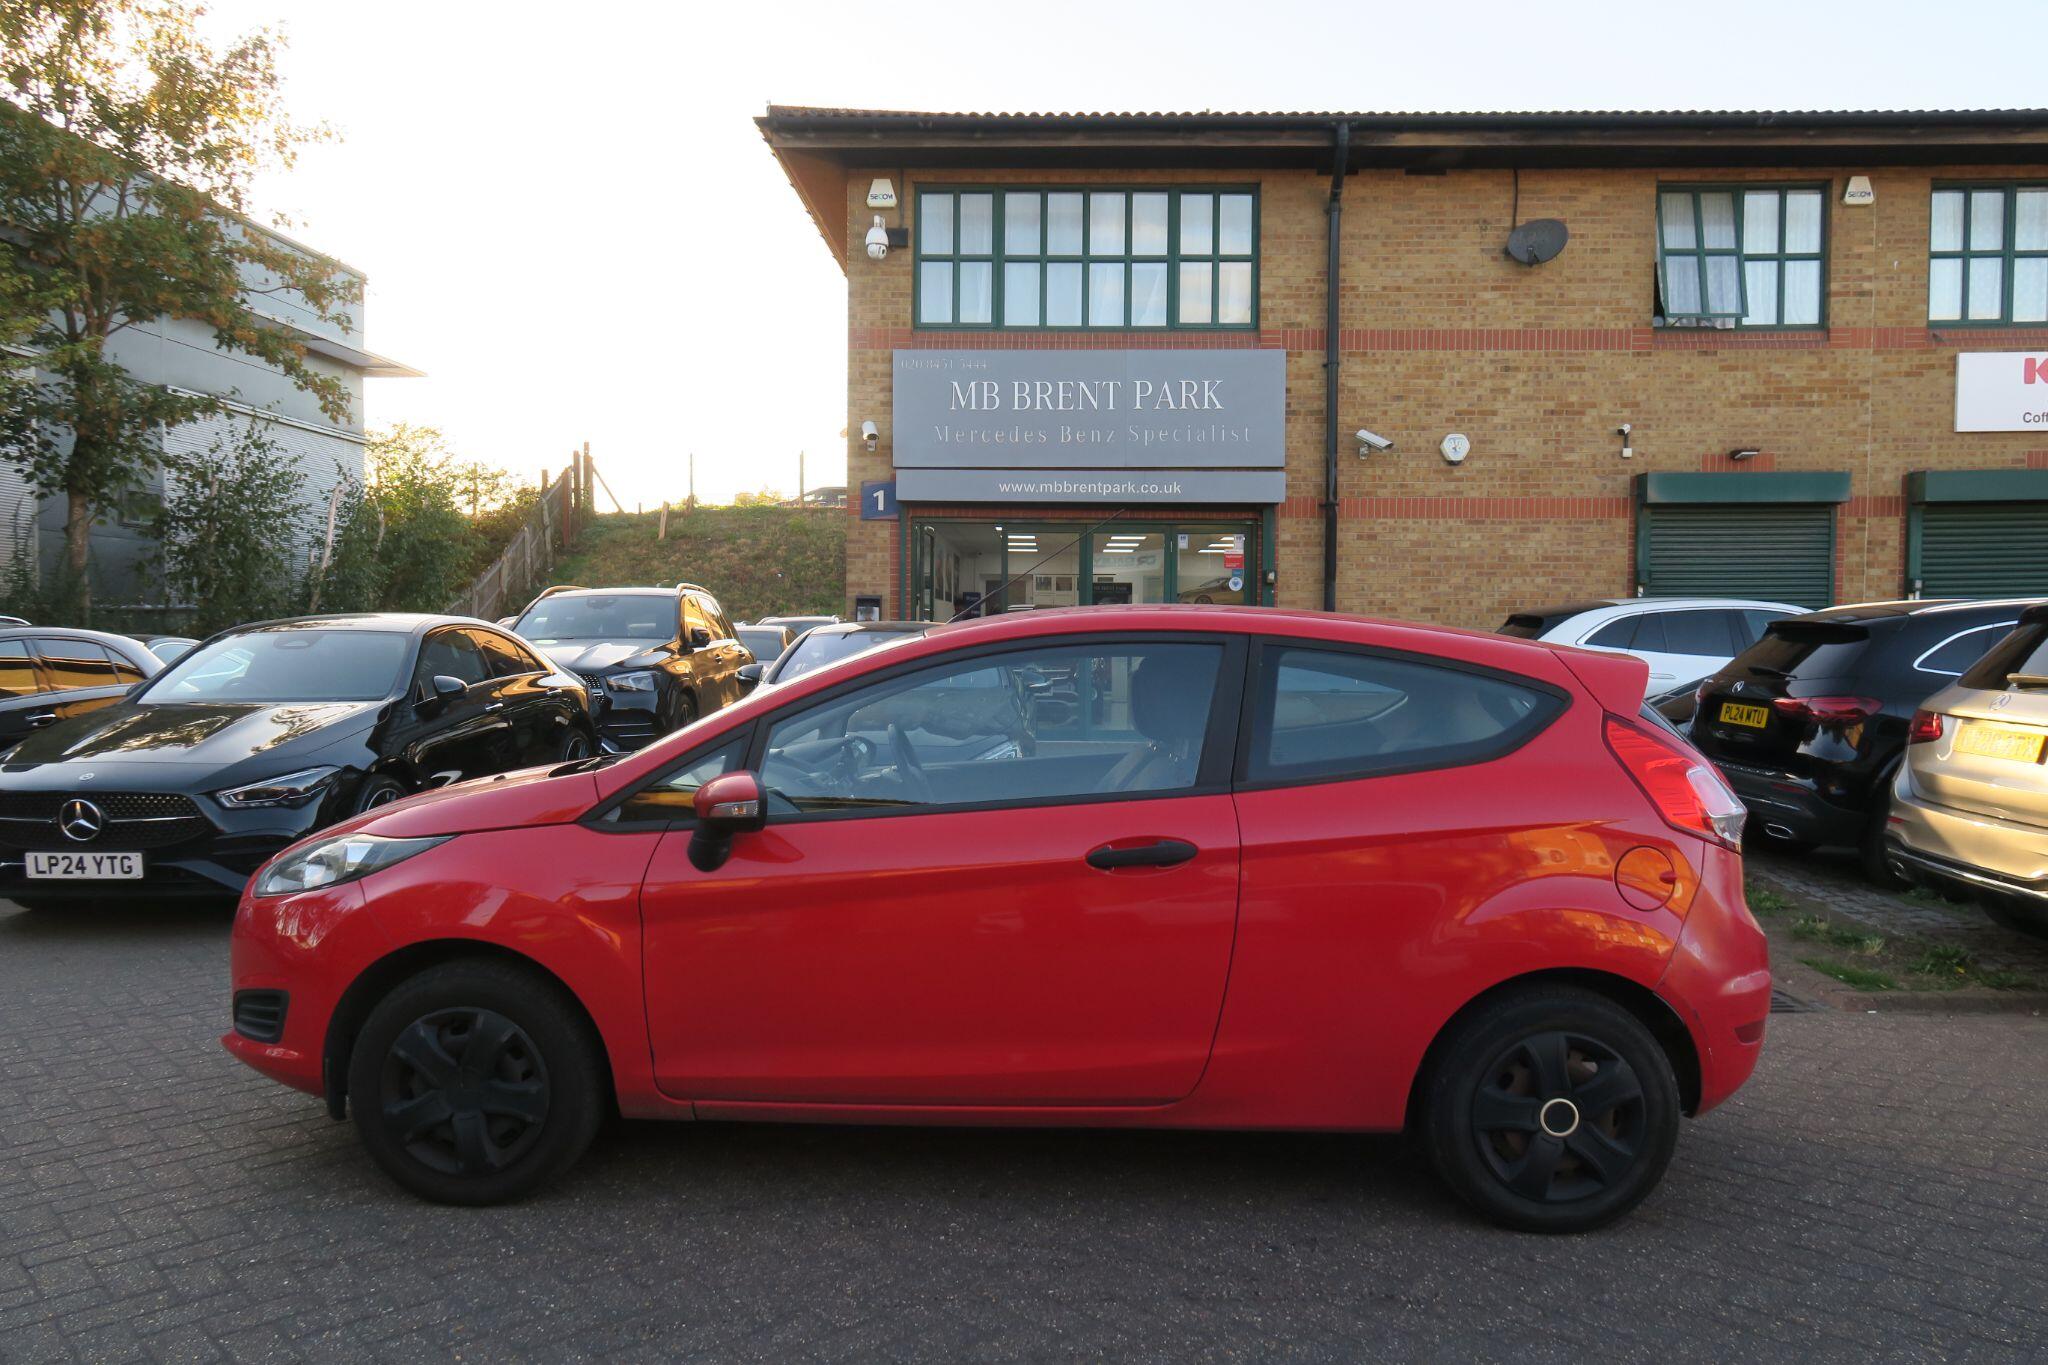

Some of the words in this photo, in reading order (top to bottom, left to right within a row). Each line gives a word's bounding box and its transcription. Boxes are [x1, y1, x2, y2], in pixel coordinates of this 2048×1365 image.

[950, 381, 1000, 410] MB
[1011, 381, 1122, 411] BRENT
[1133, 379, 1225, 410] PARK
[935, 425, 1047, 444] Mercedes
[1060, 425, 1116, 444] Benz
[1128, 424, 1250, 446] Specialist
[999, 480, 1182, 496] www.mbbrentpark.co.uk
[872, 489, 885, 511] 1
[34, 855, 87, 875] LP24
[92, 855, 133, 875] YTG
